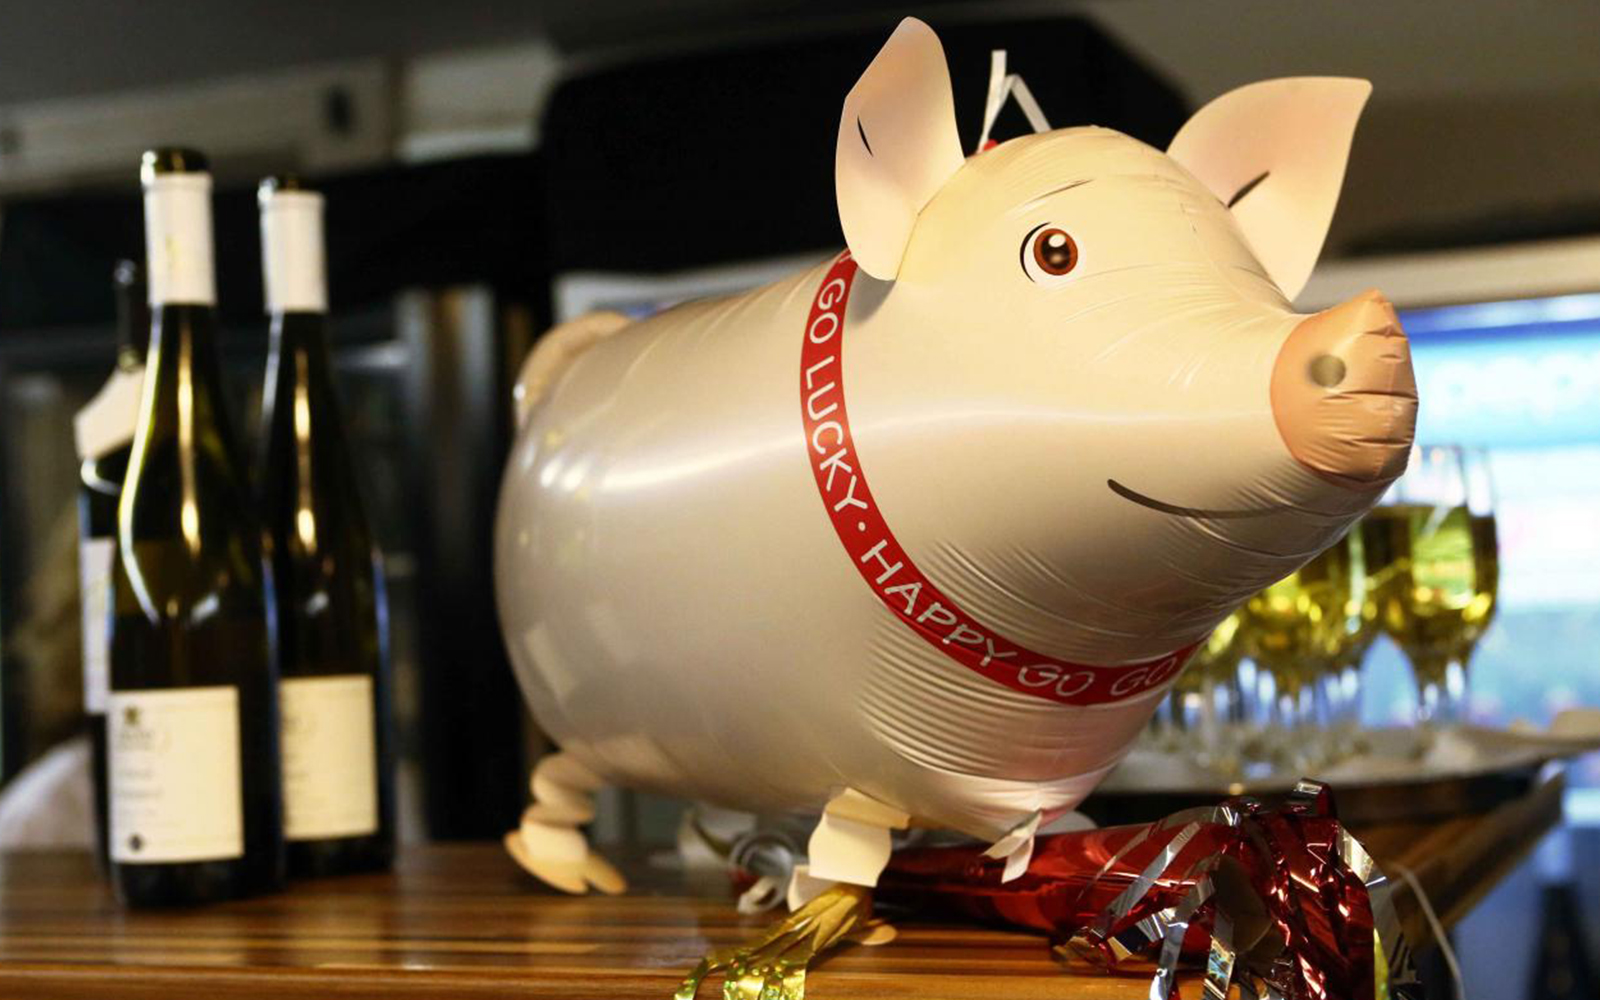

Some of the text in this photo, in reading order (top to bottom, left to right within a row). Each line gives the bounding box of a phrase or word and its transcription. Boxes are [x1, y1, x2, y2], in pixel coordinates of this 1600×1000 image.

[806, 278, 1178, 697] GO LUCKY HAPPY GO GO
